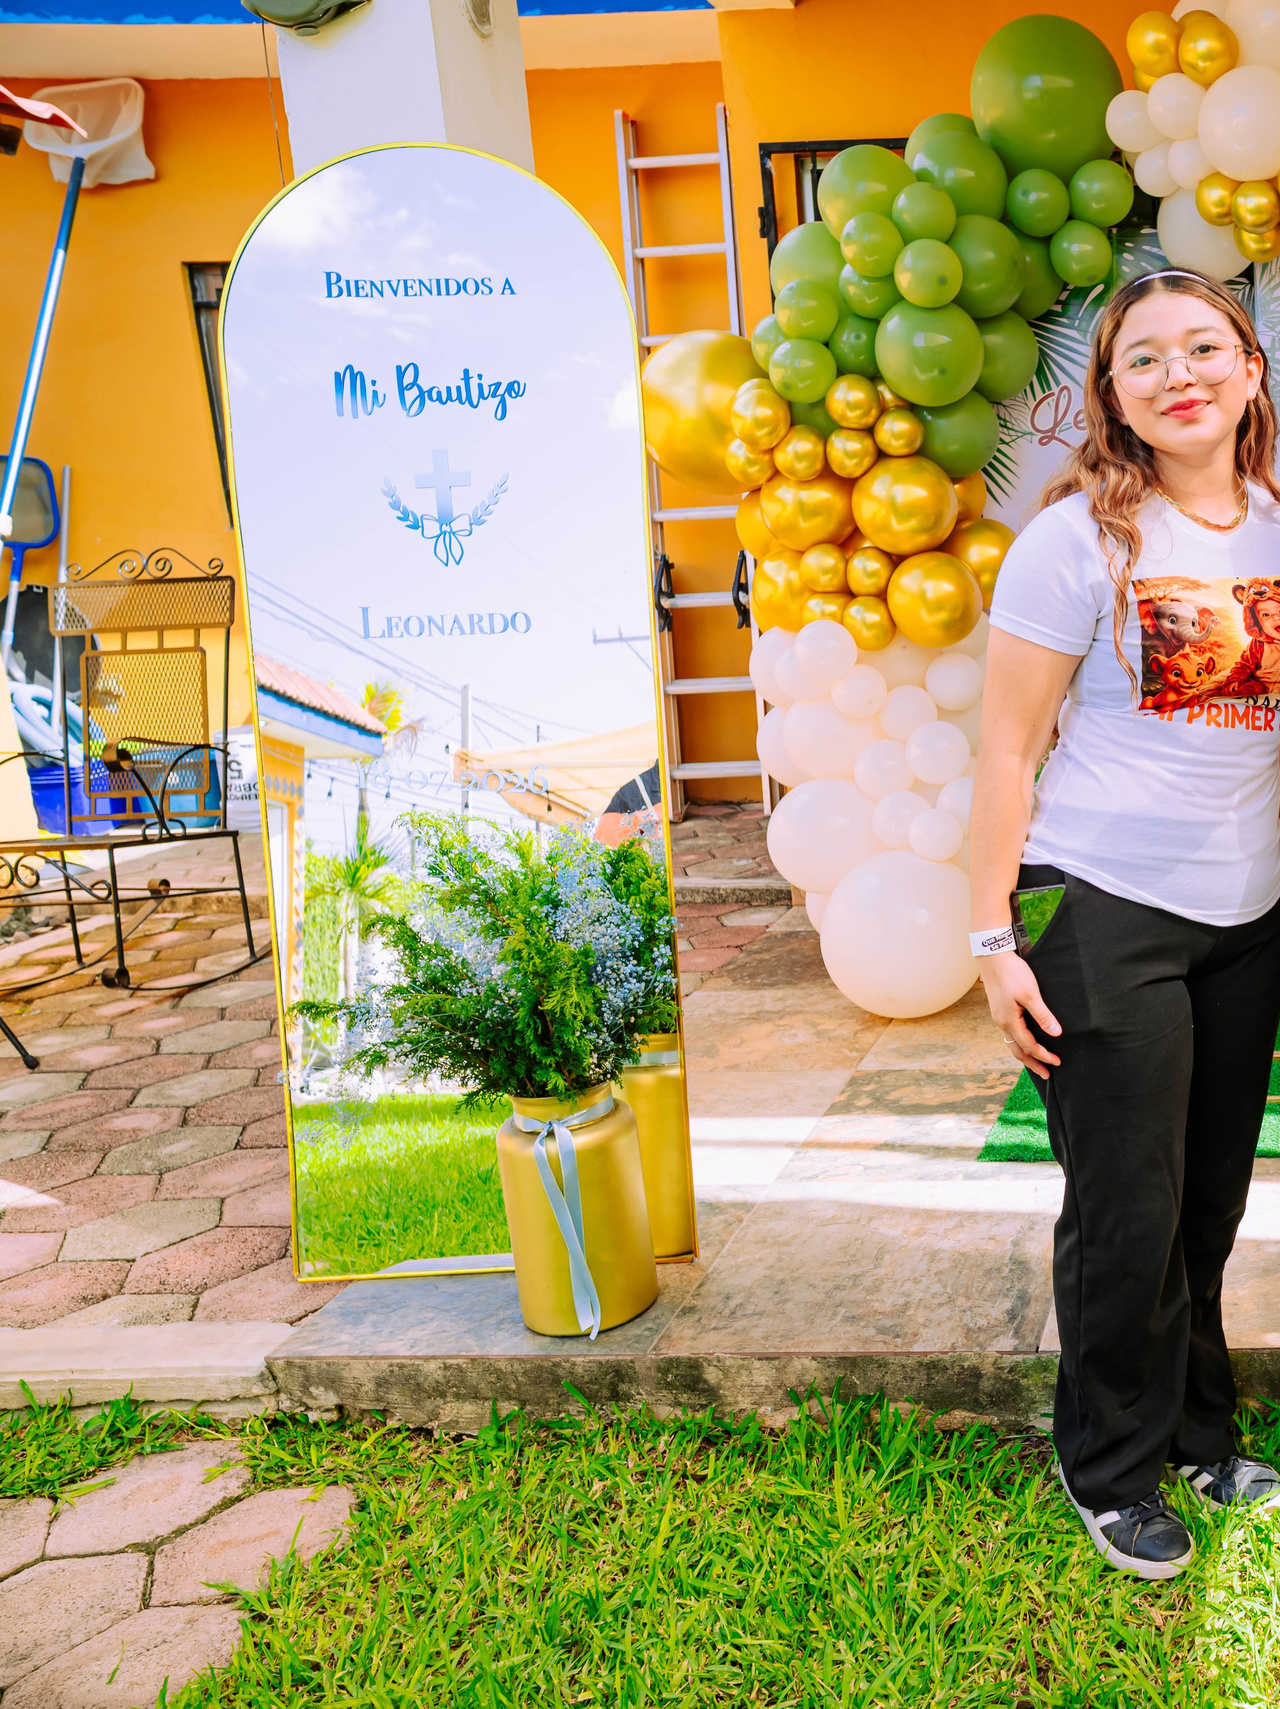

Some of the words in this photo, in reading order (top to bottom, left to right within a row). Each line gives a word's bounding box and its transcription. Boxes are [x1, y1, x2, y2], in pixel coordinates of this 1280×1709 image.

[323, 271, 493, 298] BIENVENIDOS
[500, 277, 517, 295] A
[334, 364, 386, 419] Mi
[396, 362, 526, 421] Bautizo
[1030, 385, 1087, 449] Le
[358, 606, 532, 640] LEONARDO
[1187, 703, 1276, 732] PRIMER
[228, 760, 243, 779] 5
[355, 758, 549, 795] 18.07.2026
